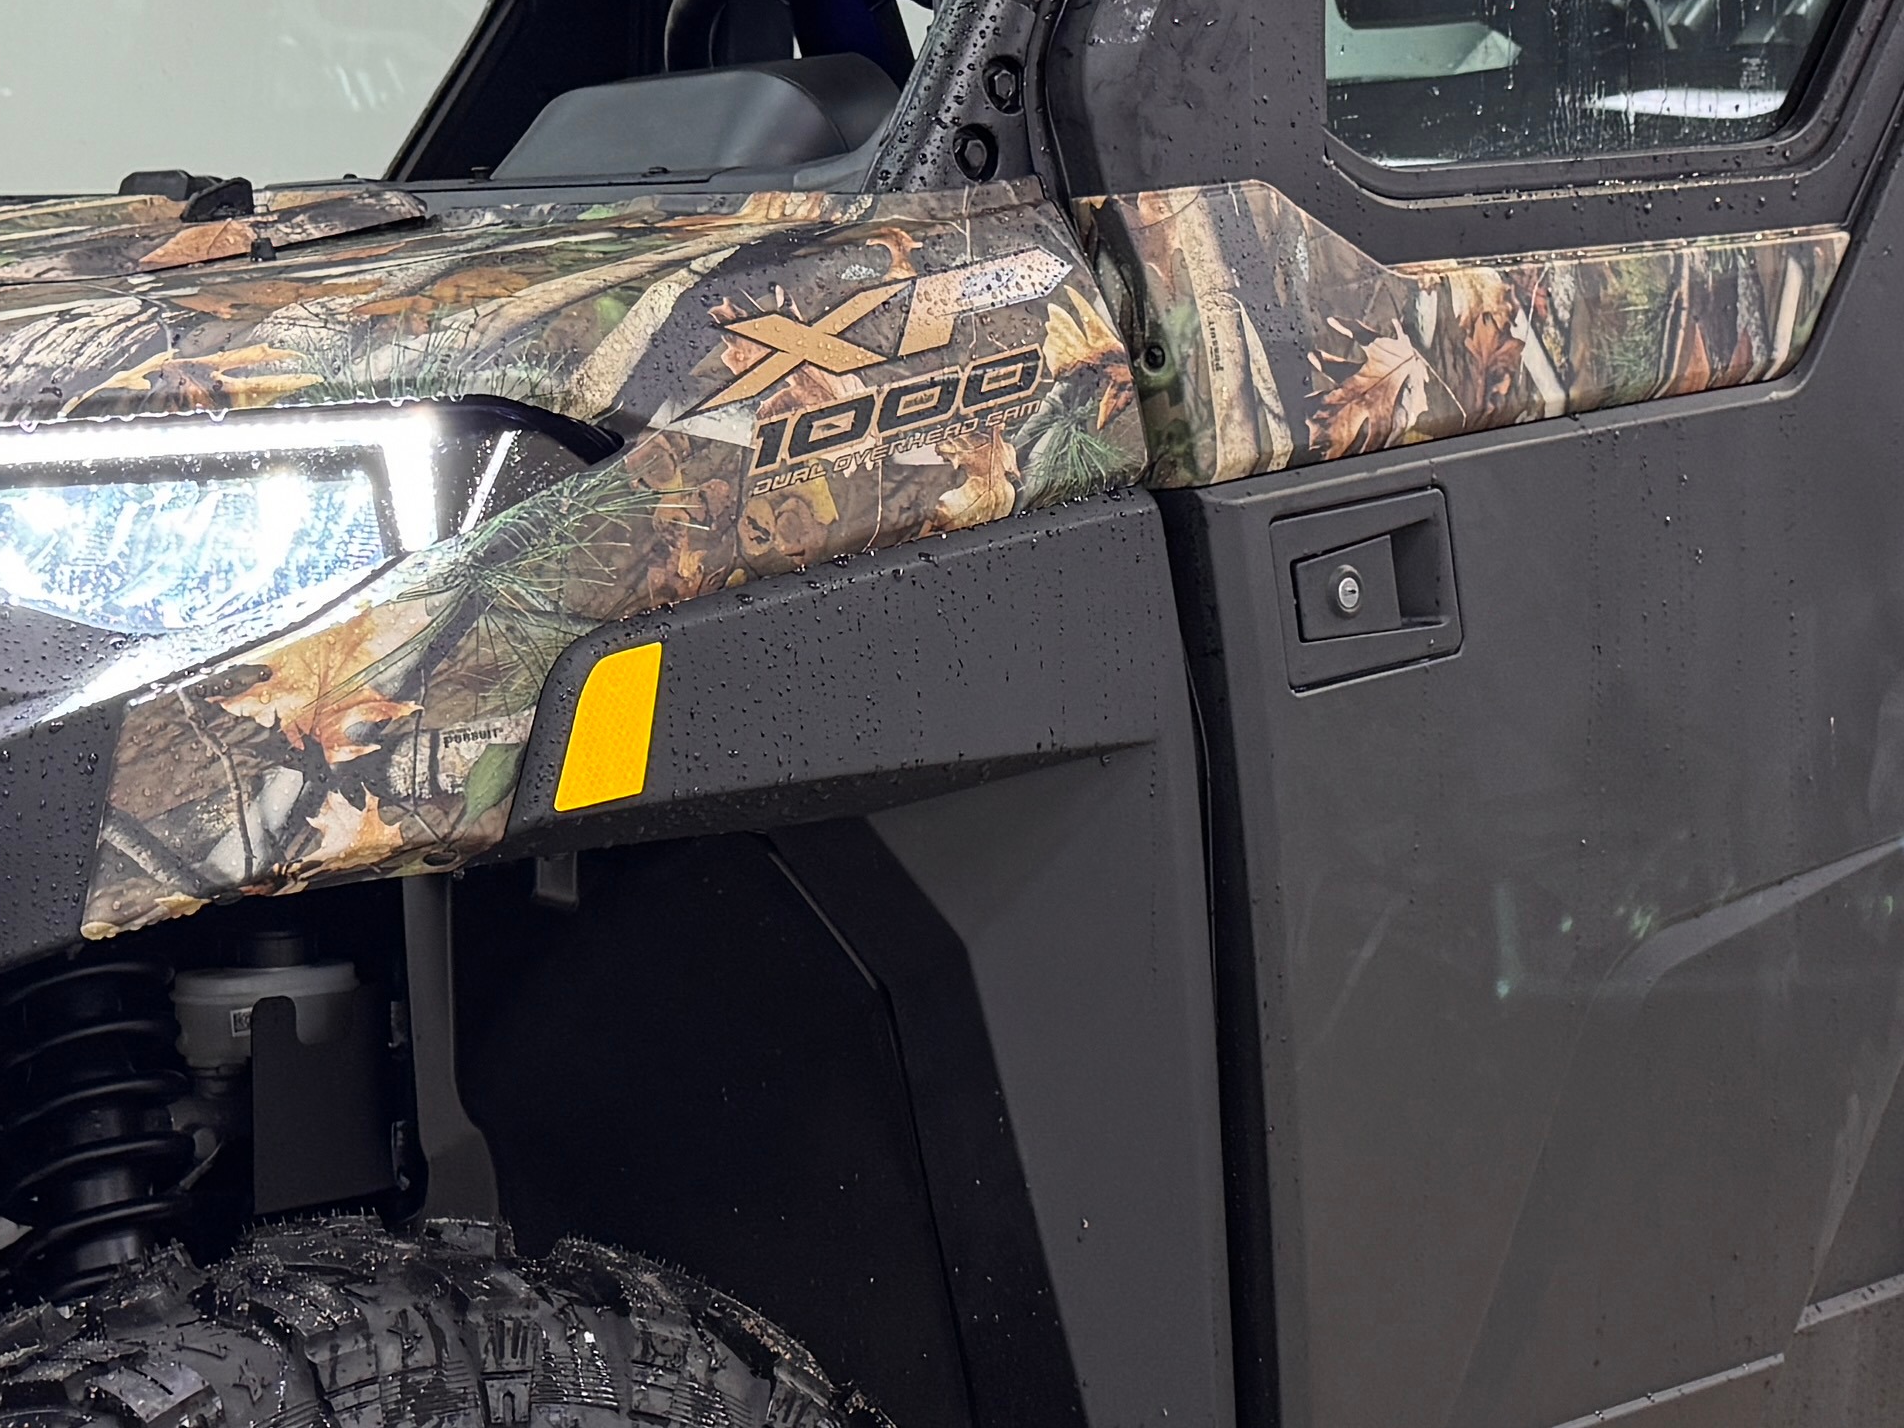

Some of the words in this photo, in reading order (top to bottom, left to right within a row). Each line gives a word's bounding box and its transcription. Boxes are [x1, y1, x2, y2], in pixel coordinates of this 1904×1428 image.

[673, 244, 1074, 419] XP
[748, 342, 1045, 477] 1000
[749, 461, 827, 497] DUAL
[832, 415, 980, 473] OVERHEAD
[984, 398, 1042, 428] CAM
